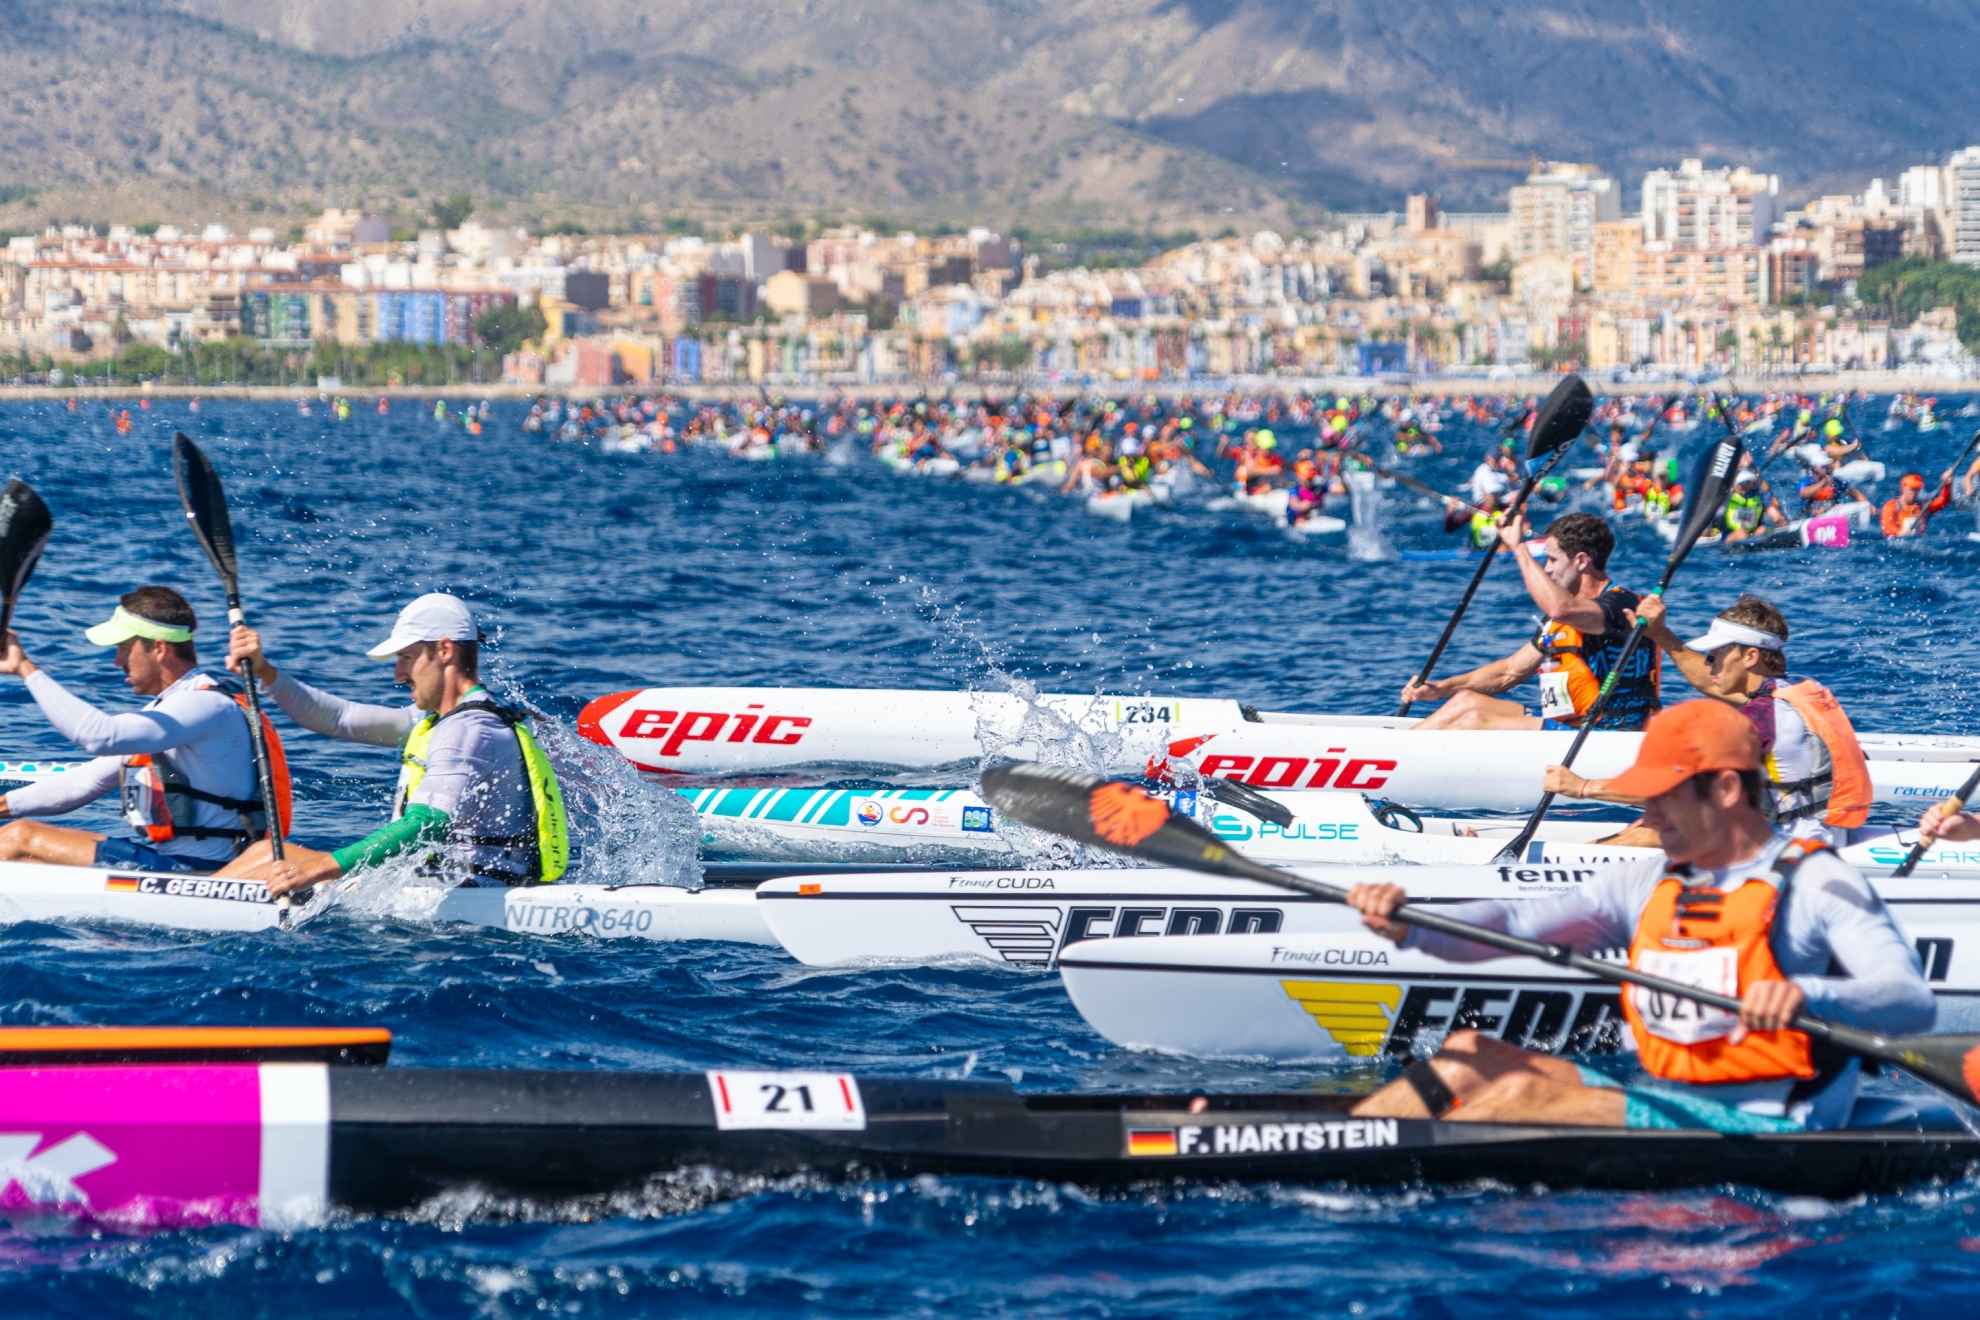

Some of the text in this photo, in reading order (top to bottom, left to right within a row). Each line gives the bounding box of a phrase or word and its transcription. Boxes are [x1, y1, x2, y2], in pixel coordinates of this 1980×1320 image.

[1126, 705, 1171, 723] 234
[619, 704, 812, 756] epic
[1259, 823, 1359, 840] PULSE
[140, 878, 162, 894] C.
[996, 878, 1055, 889] CUDA
[504, 904, 653, 932] NITRO 640
[1323, 949, 1389, 966] CUDA
[760, 1085, 814, 1112] 21
[1179, 1118, 1399, 1154] F. HARTSTEIN
